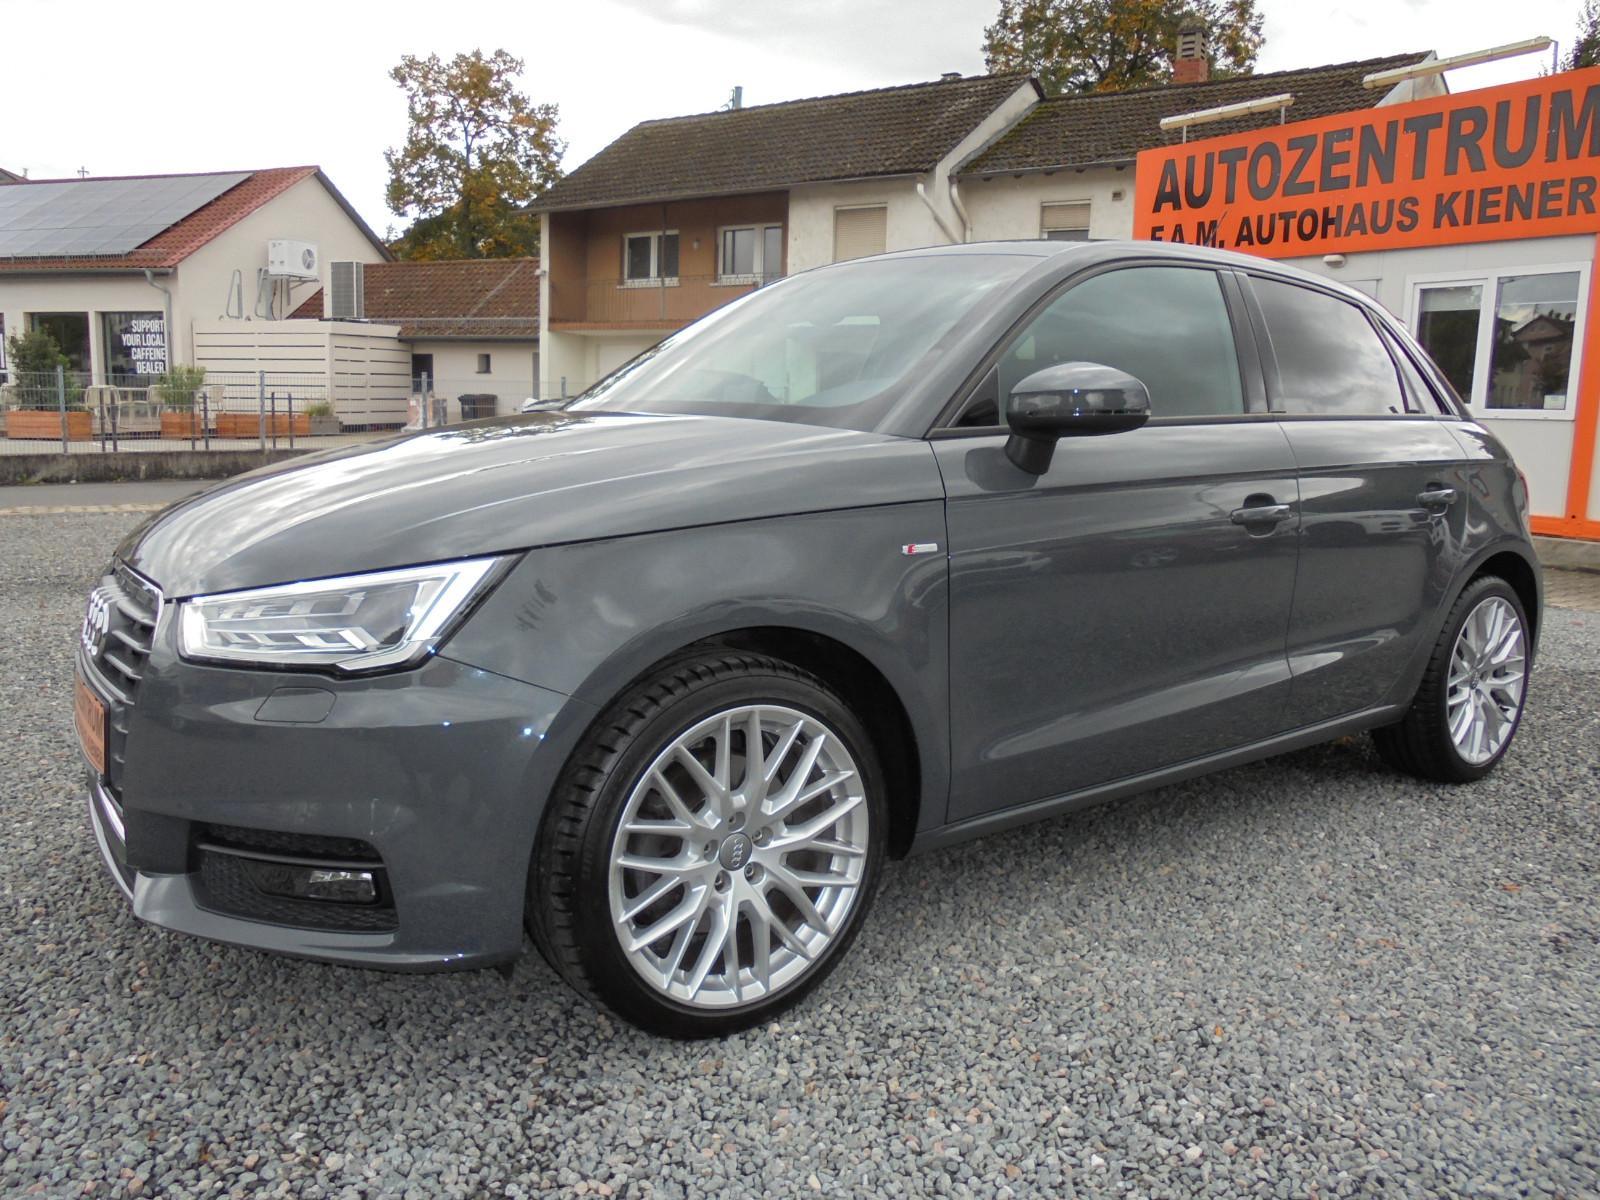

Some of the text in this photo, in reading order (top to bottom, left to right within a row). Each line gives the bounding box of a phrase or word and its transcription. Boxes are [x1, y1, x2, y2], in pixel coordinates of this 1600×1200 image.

[1152, 84, 1600, 213] AUTOZENTRUM
[1235, 197, 1419, 248] AUTOHAUS
[1433, 176, 1597, 228] KIENER
[131, 320, 164, 332] SUPPORT
[122, 334, 165, 346] YOUR LOCAL
[131, 347, 166, 360] CAFFEINE
[136, 361, 165, 373] DEALER
